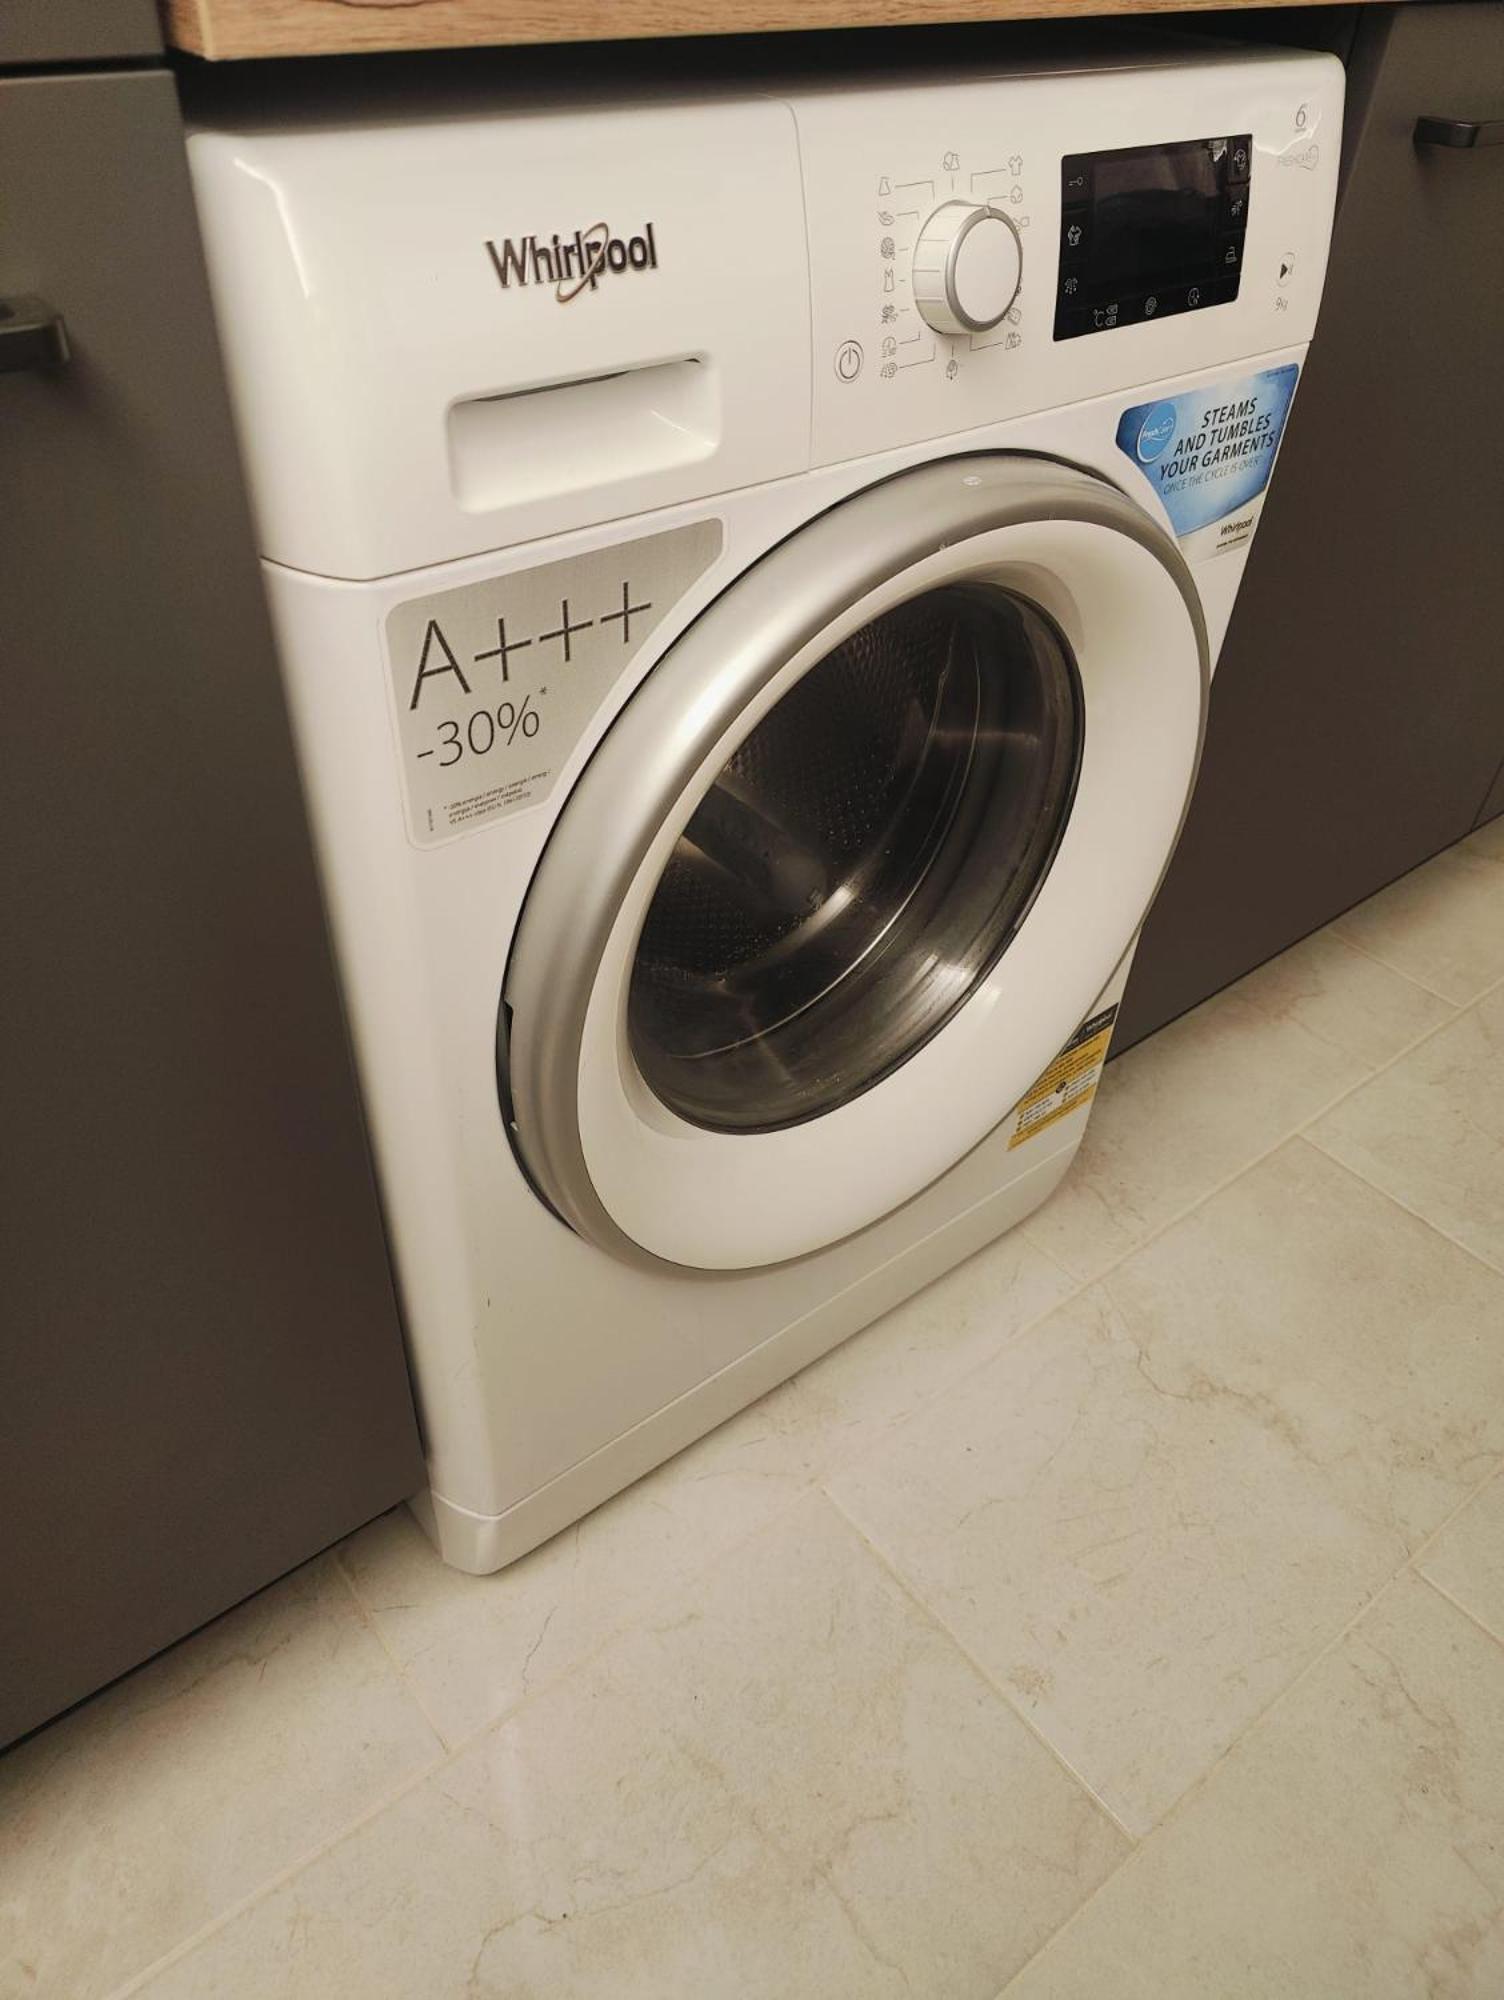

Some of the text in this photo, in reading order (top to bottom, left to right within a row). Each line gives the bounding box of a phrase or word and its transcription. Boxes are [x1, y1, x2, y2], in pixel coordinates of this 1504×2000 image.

[1295, 103, 1307, 128] 6
[485, 222, 659, 293] Whirlpool
[1173, 413, 1272, 457] AND TUMBLES
[1201, 397, 1258, 429] STEAMS
[1160, 431, 1276, 481] YOUR GARMENTS
[1163, 479, 1187, 495] ONCE
[1188, 473, 1204, 488] THE
[1204, 465, 1232, 483] CYCLE
[409, 582, 652, 711] A+++
